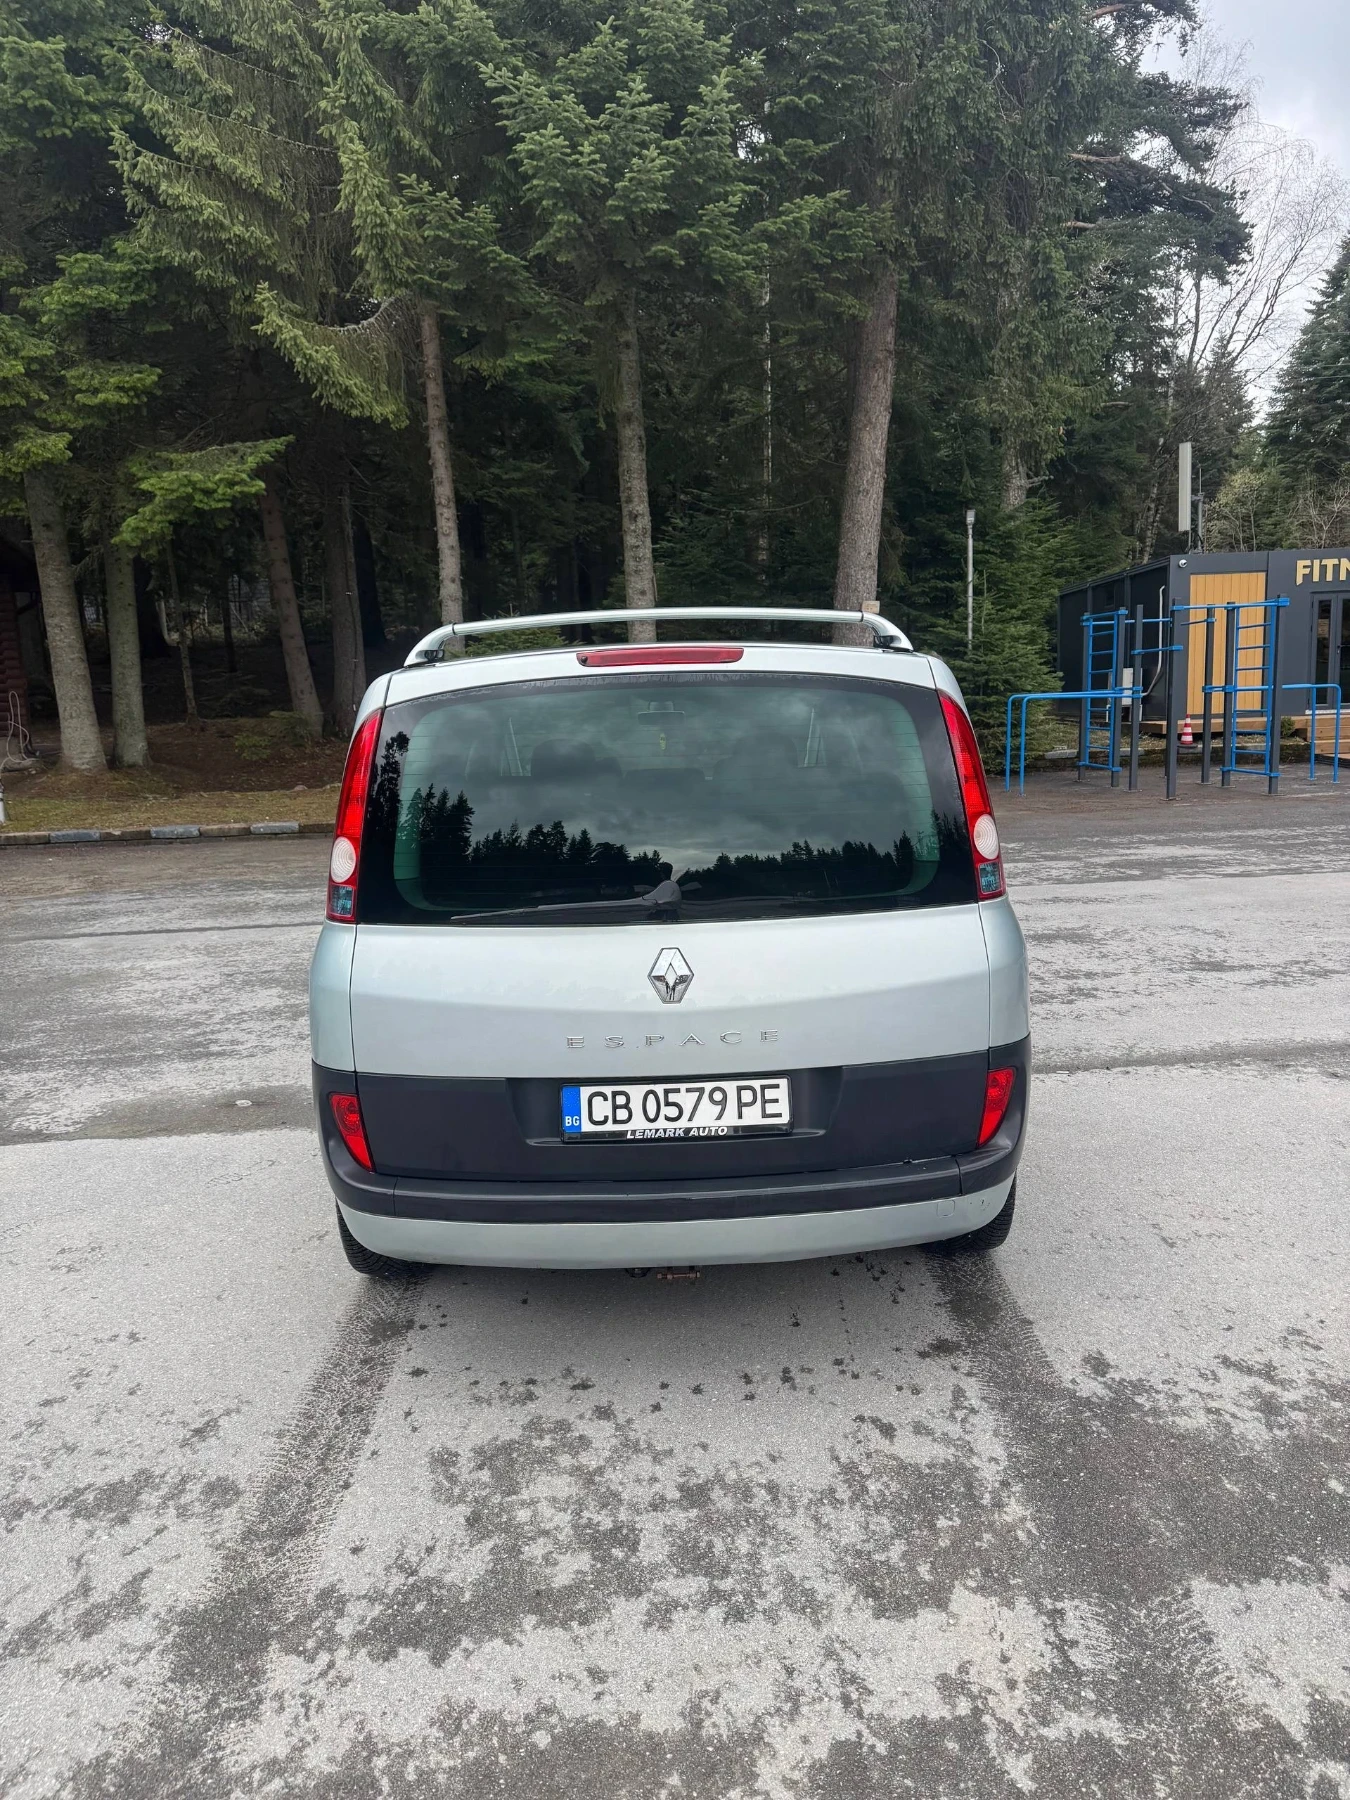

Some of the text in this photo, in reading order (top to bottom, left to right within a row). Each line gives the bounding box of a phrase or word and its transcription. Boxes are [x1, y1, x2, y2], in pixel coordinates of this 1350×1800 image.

[566, 1029, 779, 1048] ESPACE
[587, 1083, 783, 1126] CB 0579 PE
[565, 1115, 580, 1127] BG
[626, 1126, 728, 1139] LEMARK AUTO
